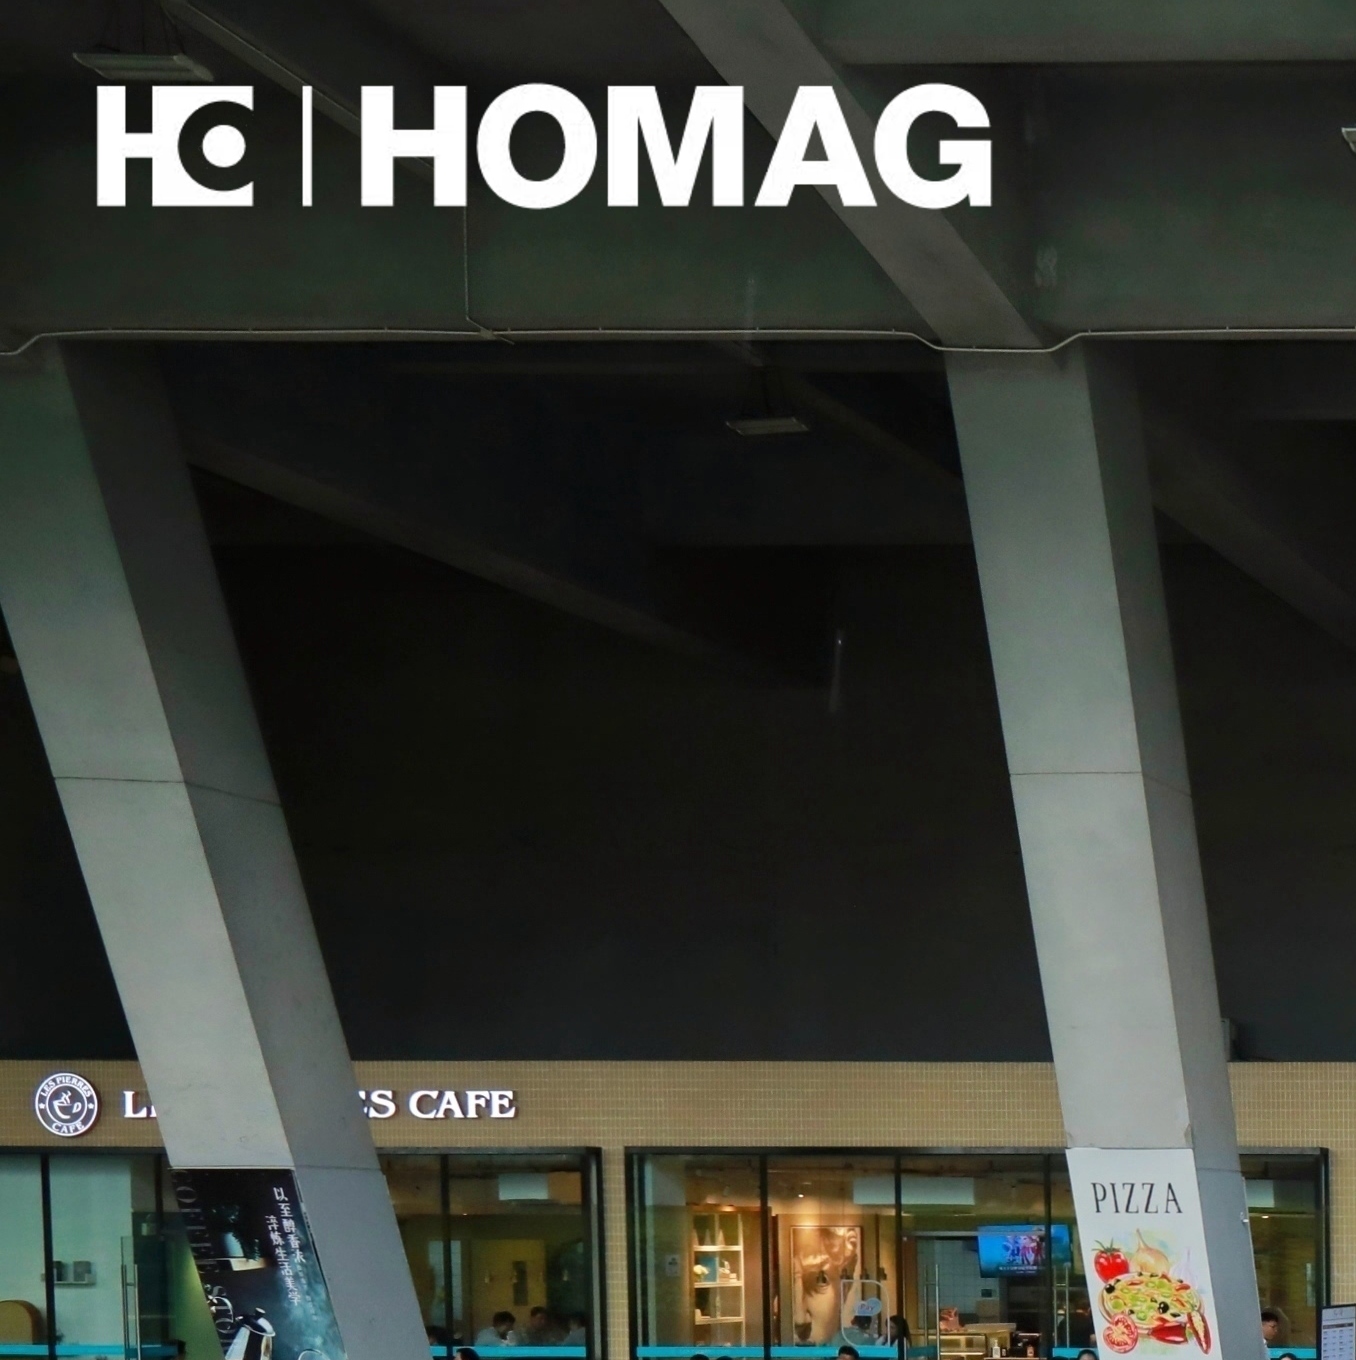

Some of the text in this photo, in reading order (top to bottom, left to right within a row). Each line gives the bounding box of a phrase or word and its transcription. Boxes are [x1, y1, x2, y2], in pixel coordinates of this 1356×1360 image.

[40, 1075, 92, 1098] LES PIERRES
[408, 1090, 517, 1119] CAFE
[51, 1121, 85, 1134] CAFE
[1090, 1182, 1183, 1214] PIZZA
